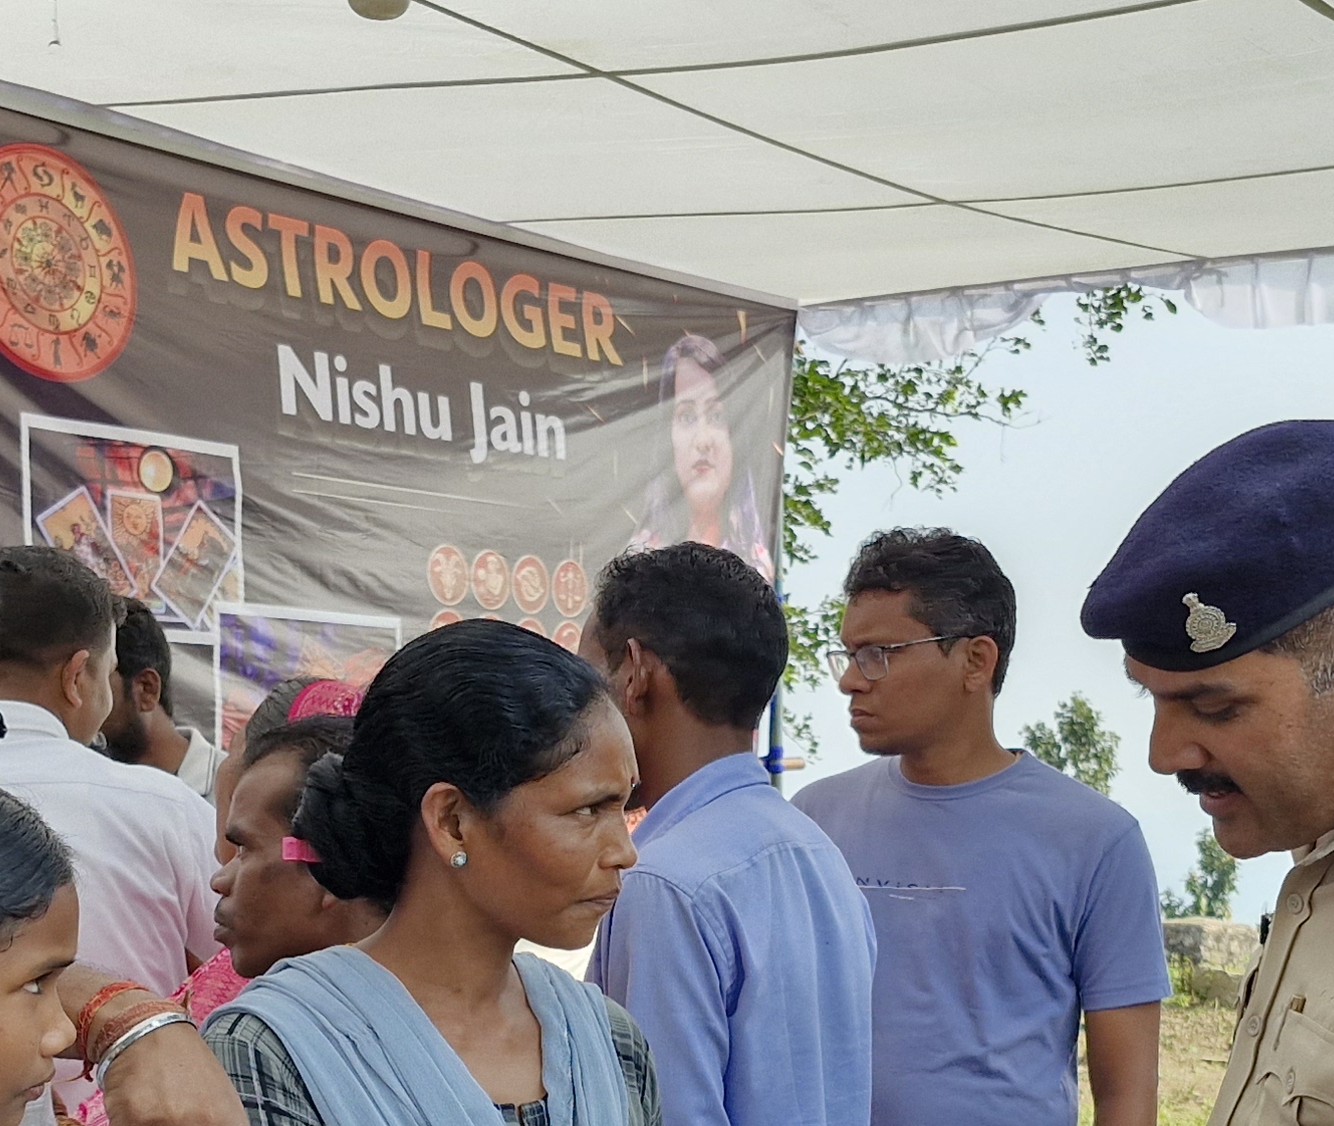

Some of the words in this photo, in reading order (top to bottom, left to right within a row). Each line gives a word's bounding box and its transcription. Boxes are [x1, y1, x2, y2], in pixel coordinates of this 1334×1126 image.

[172, 192, 624, 365] ASTROLOGER
[275, 344, 453, 442] Nishu
[468, 381, 567, 464] Jain
